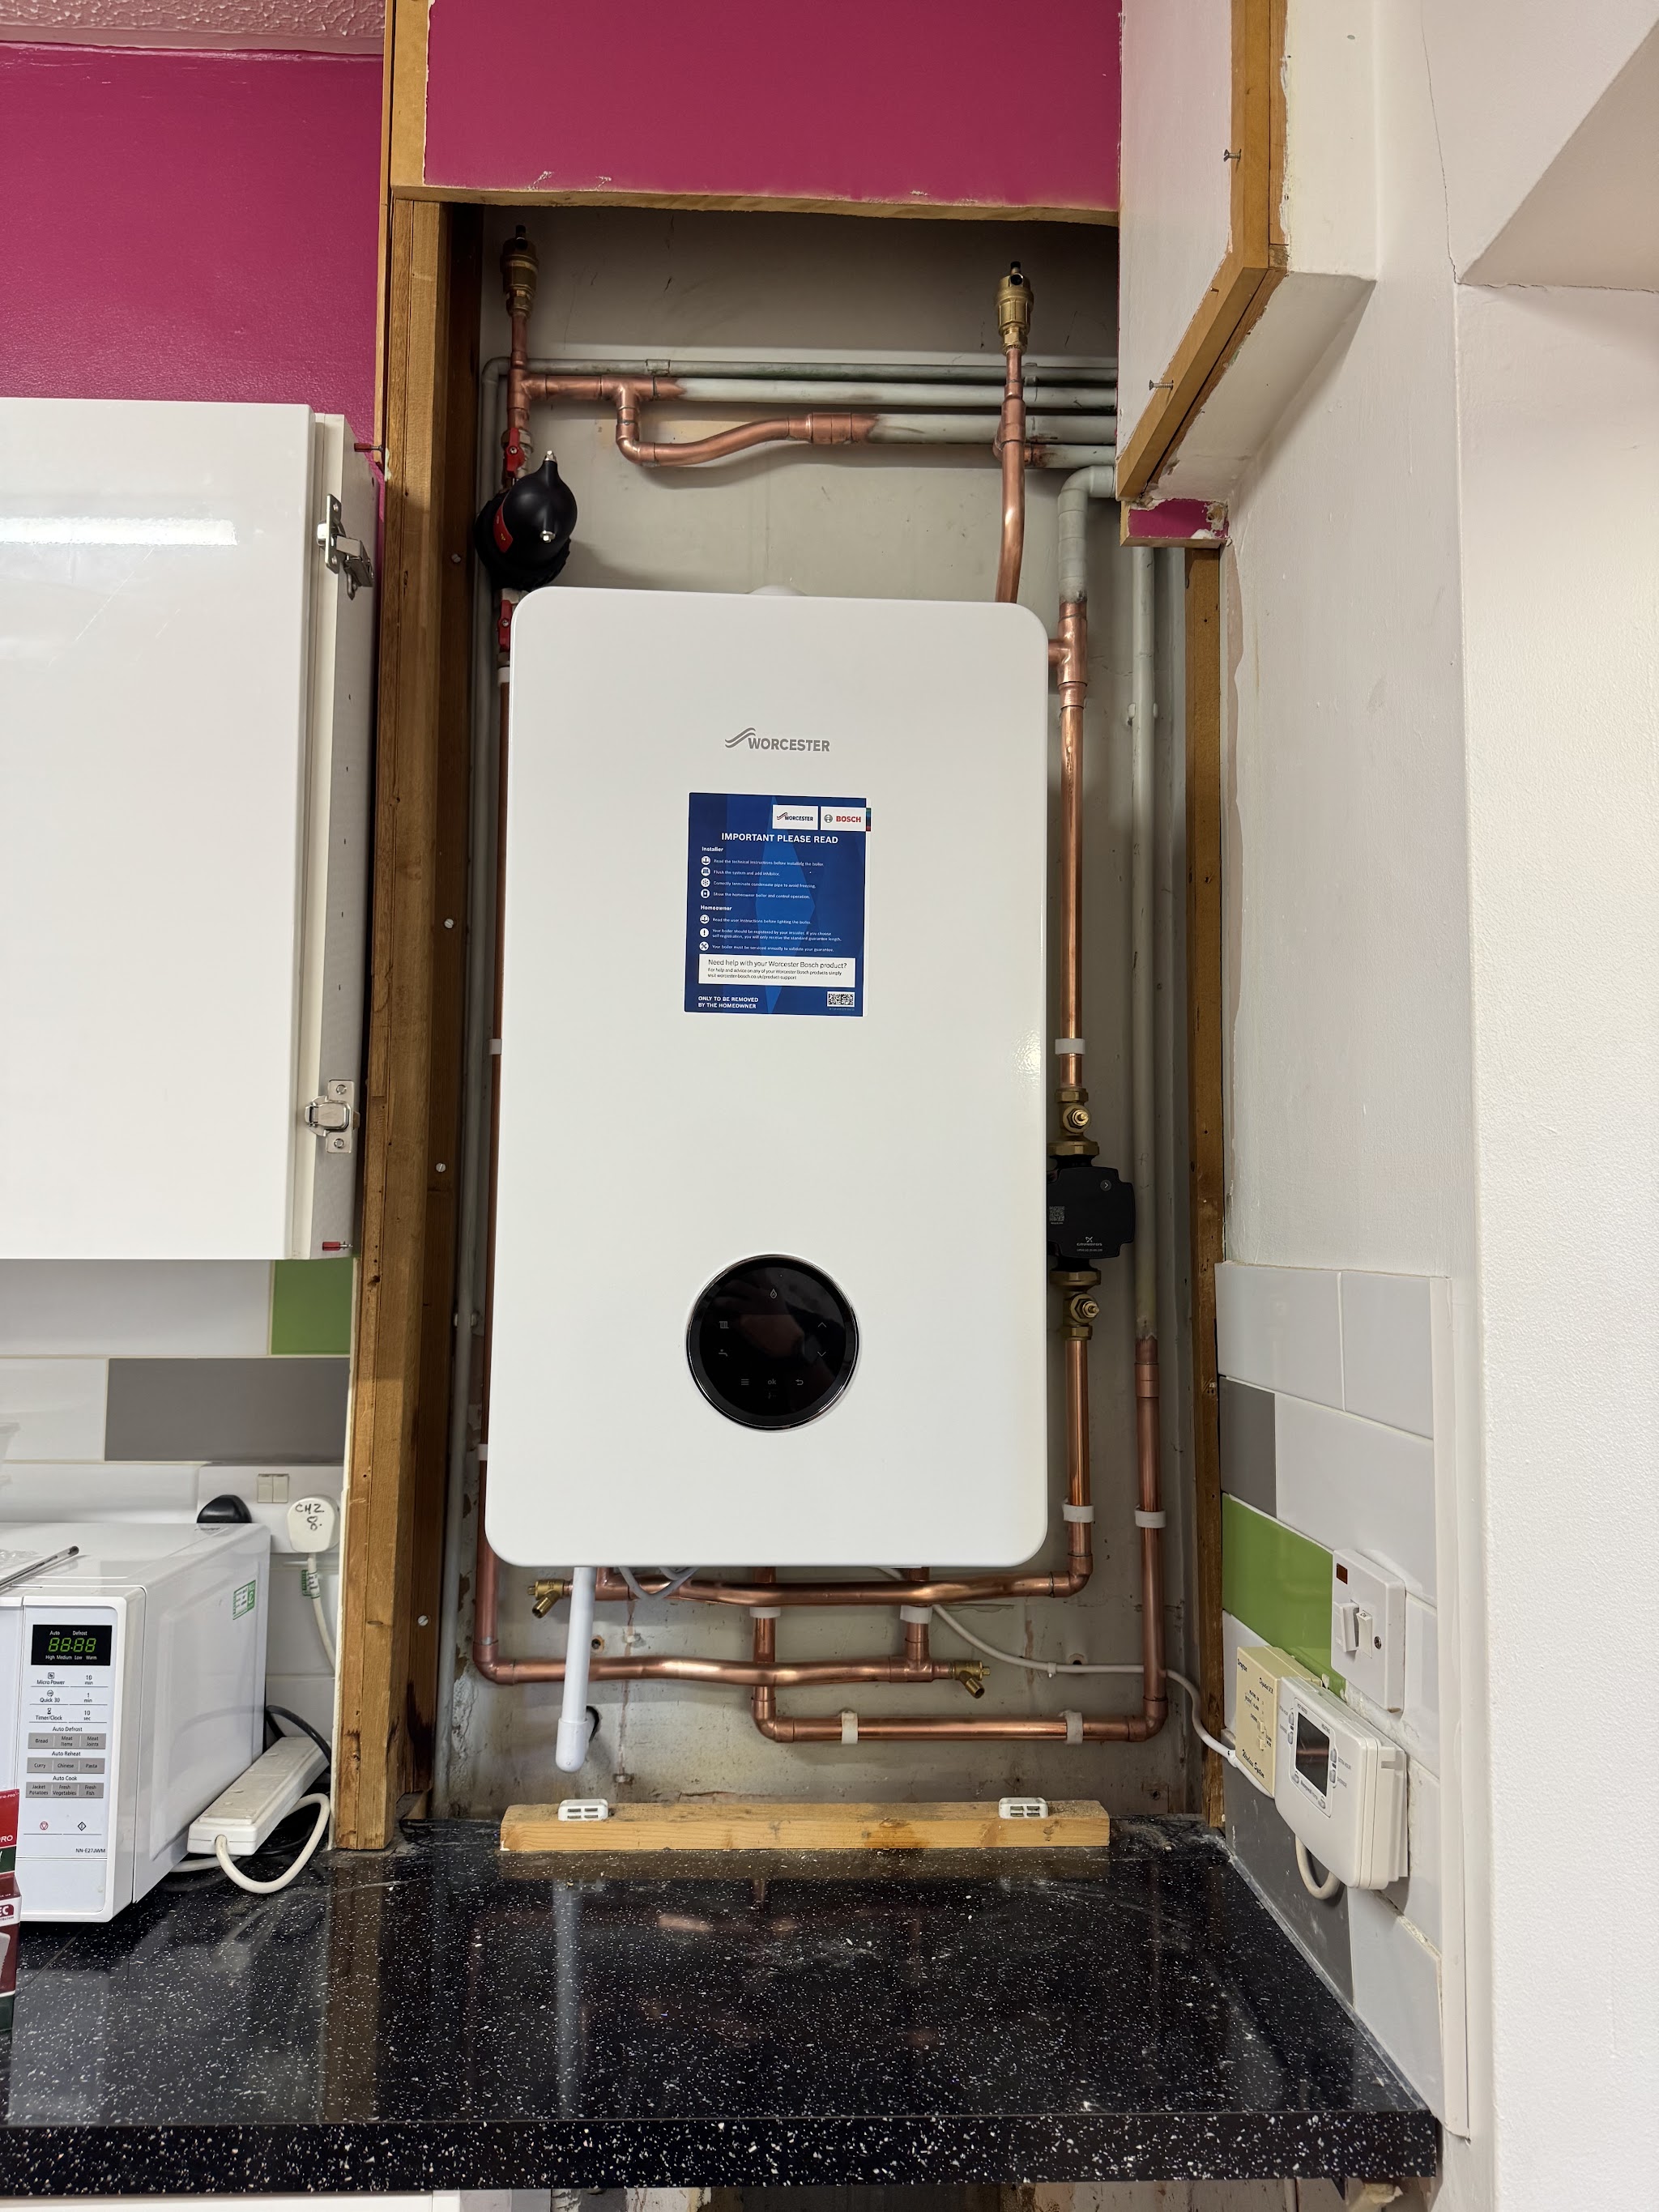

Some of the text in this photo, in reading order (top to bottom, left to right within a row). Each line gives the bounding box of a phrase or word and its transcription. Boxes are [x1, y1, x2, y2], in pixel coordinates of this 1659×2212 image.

[748, 737, 830, 752] WORCESTER
[721, 833, 839, 844] IMPORTANT PLEASE READ
[1242, 1749, 1265, 1779] Wireless System
